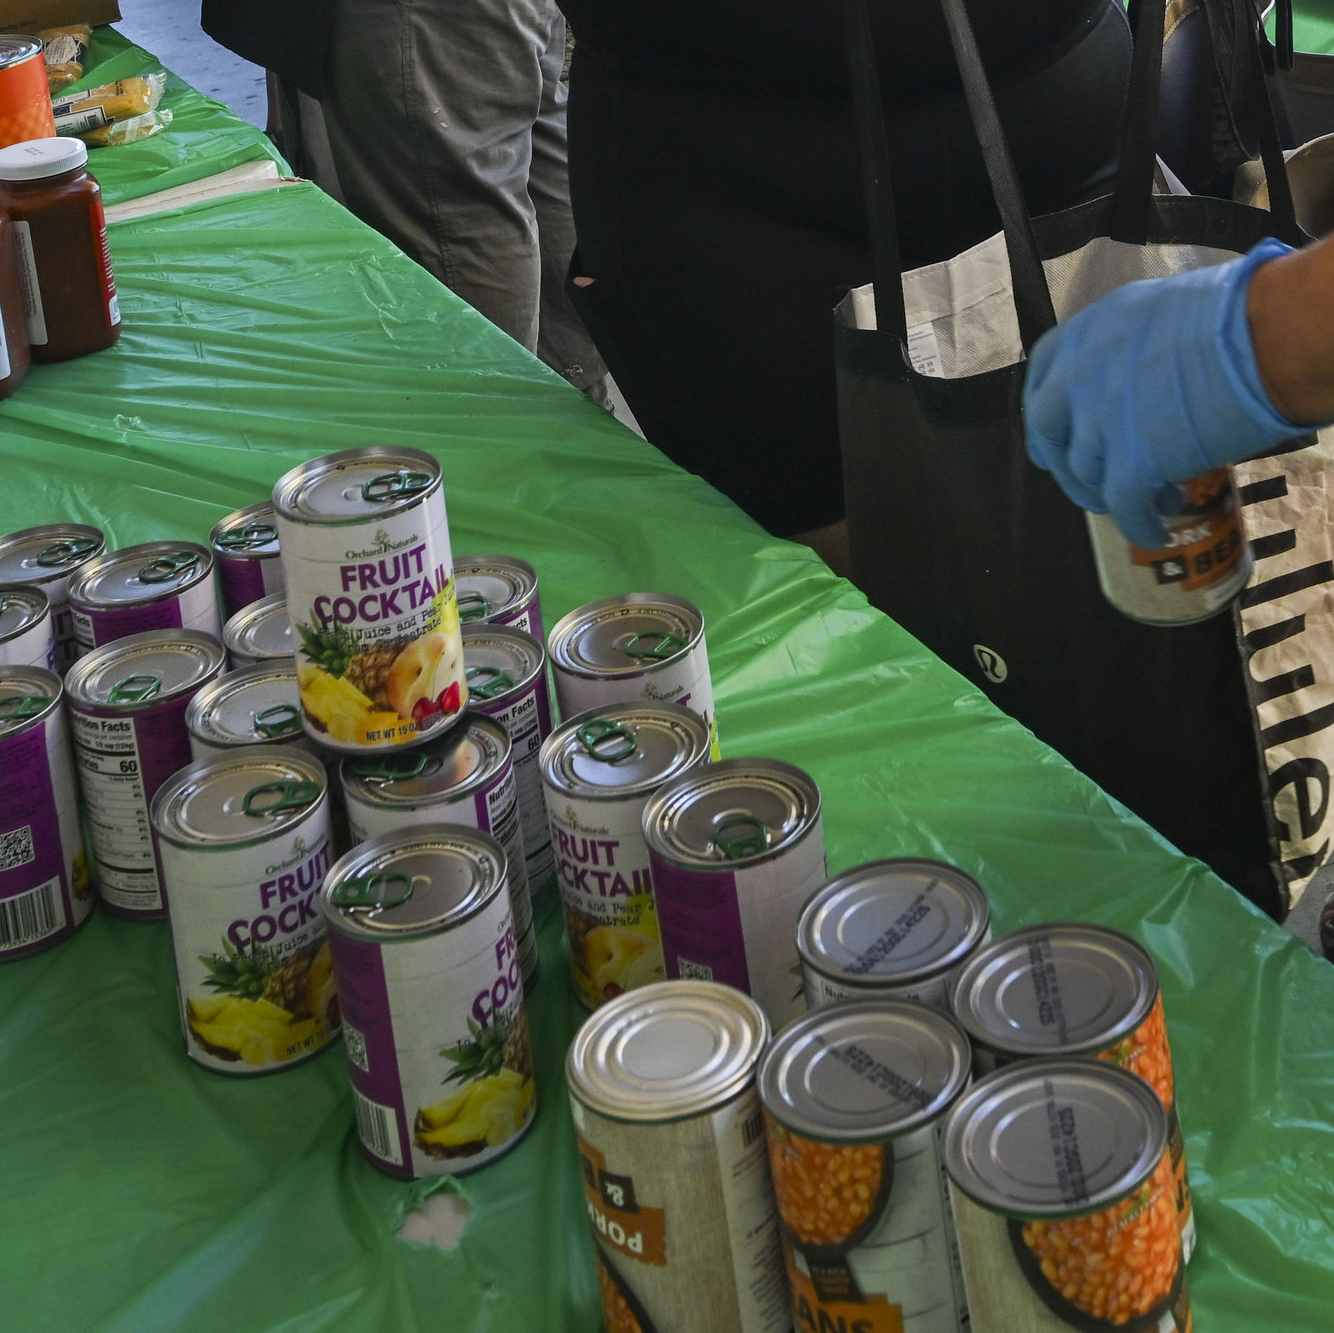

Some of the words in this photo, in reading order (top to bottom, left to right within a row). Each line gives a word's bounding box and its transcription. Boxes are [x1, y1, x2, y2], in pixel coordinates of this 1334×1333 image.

[345, 546, 384, 560] Orchard
[385, 533, 419, 551] Naturals
[1164, 522, 1212, 548] ORK
[1162, 561, 1183, 576] &
[1196, 528, 1241, 575] BEA
[340, 543, 426, 592] FRUIT
[314, 564, 449, 625] COCKTAIL
[357, 625, 391, 640] Juice
[397, 619, 416, 632] and
[422, 602, 441, 621] Pear
[514, 617, 527, 629] cts
[512, 699, 535, 718] Facts
[101, 721, 131, 732] Facts
[366, 727, 381, 741] NET
[383, 724, 395, 738] WT
[398, 722, 409, 735] 15
[528, 734, 540, 751] 60
[119, 760, 138, 773] 60
[551, 822, 619, 866] FRUIT
[259, 841, 330, 910] FRUIT
[558, 856, 652, 898] CKTAIL
[227, 884, 321, 948] COCK
[587, 900, 607, 912] and
[613, 902, 641, 914] Pear
[276, 932, 310, 953] Juice
[605, 1181, 625, 1207] &
[587, 1202, 644, 1255] PORK
